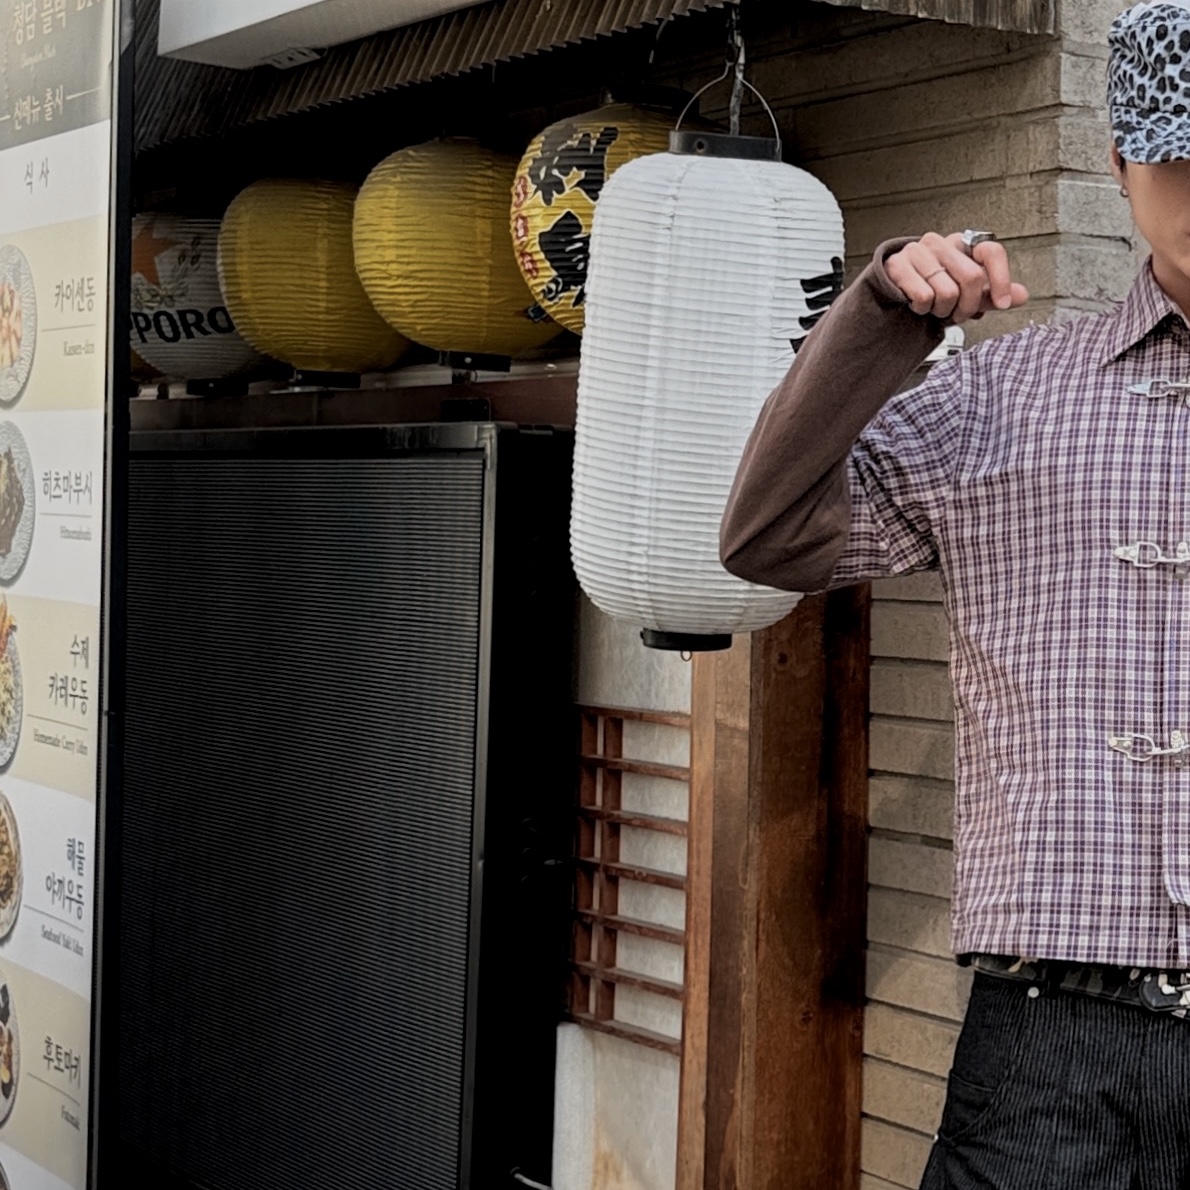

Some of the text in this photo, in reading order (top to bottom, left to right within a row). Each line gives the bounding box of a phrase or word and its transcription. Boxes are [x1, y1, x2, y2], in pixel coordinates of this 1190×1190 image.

[14, 84, 64, 130] 신메뉴 출시
[54, 277, 96, 312] 카이센동
[129, 306, 236, 344] PORO
[42, 470, 92, 505] 히츠마부시
[70, 635, 89, 669] 수제
[48, 672, 89, 716] 카레우동
[66, 838, 85, 877] 해물
[45, 872, 84, 920] 야끼우동
[43, 1036, 81, 1089] 후토마키
